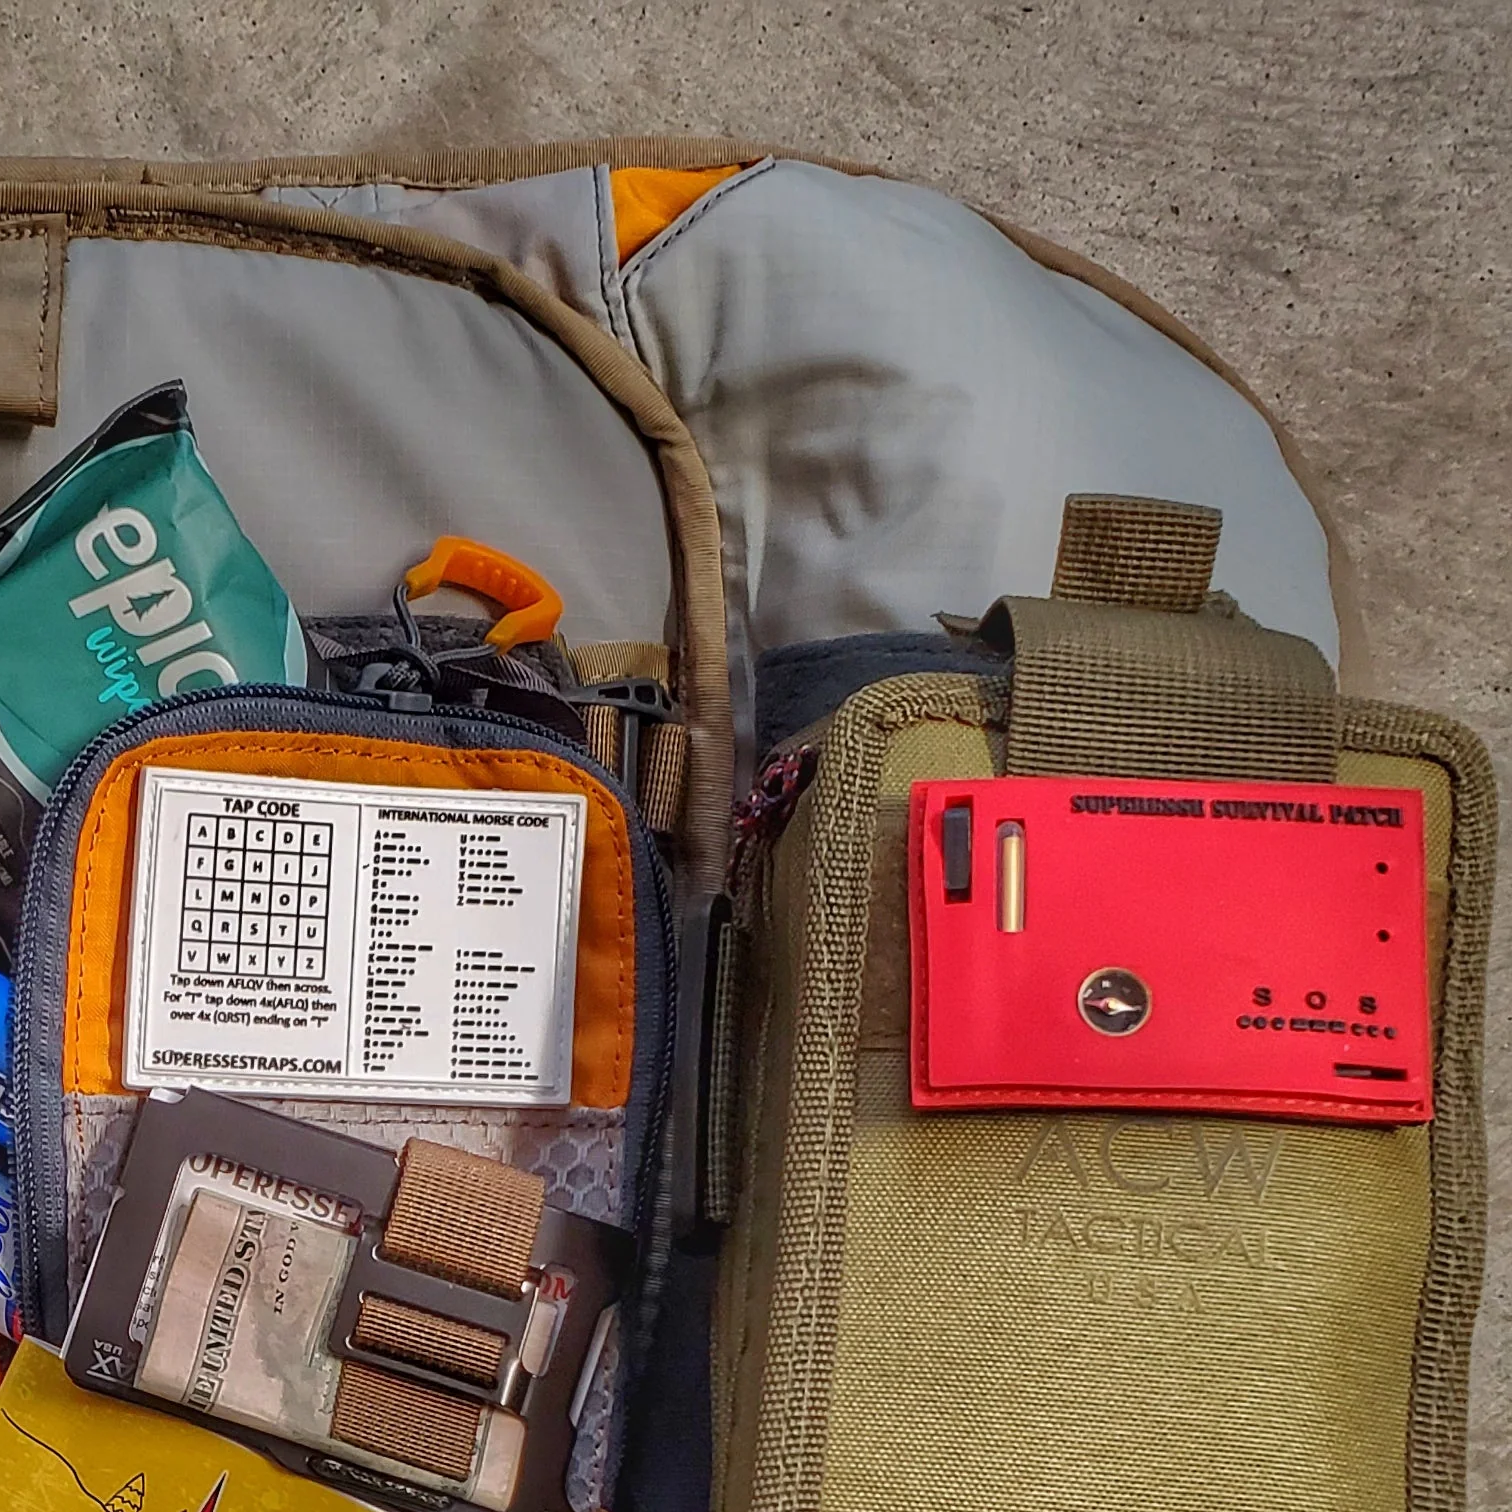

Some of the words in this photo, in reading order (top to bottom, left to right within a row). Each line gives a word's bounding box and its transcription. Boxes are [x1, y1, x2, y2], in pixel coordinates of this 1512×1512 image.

[223, 798, 254, 814] TAP
[257, 801, 300, 817] CODE
[1212, 800, 1324, 823] SURVIVAL
[1329, 804, 1403, 829] PATCH
[378, 809, 470, 824] INTERNATIONAL
[473, 813, 514, 825] MORSE
[517, 816, 549, 828] CODE
[197, 825, 207, 838] A
[227, 827, 236, 841] B
[255, 829, 265, 842] C
[283, 831, 294, 845] D
[312, 833, 321, 847] E
[197, 857, 205, 869] F
[224, 859, 235, 871] G
[252, 860, 263, 873] H
[283, 862, 289, 875] I
[311, 865, 318, 877] J
[195, 888, 203, 901] L
[220, 889, 235, 902] M
[250, 891, 262, 905] N
[279, 893, 291, 907] O
[309, 895, 318, 908] P
[191, 919, 203, 933] Q
[221, 921, 230, 933] R
[249, 923, 259, 936] S
[278, 925, 288, 937] T
[306, 926, 317, 939] U
[187, 950, 197, 962] V
[216, 952, 231, 964] W
[248, 954, 257, 966] X
[277, 955, 286, 968] Y
[305, 957, 314, 970] Z
[170, 974, 190, 987] Tap
[193, 975, 224, 988] down
[227, 977, 263, 991] AFLQV
[266, 979, 291, 992] then
[294, 983, 332, 994] across.
[164, 991, 182, 1002] For
[205, 994, 223, 1007] tap
[226, 994, 256, 1007] down
[311, 999, 336, 1011] then
[1253, 987, 1272, 1006] S
[1305, 991, 1327, 1009] O
[1359, 995, 1377, 1014] S
[170, 1011, 195, 1020] over
[197, 1010, 211, 1021] 4x
[214, 1011, 250, 1026] (QRST)
[253, 1014, 290, 1028] ending
[293, 1018, 307, 1027] on
[152, 1049, 341, 1073] SUPERESSESTRAPS.COM
[1015, 1114, 1285, 1204] ACW
[279, 1238, 297, 1283] GOD
[274, 1289, 285, 1315] IN
[202, 1266, 247, 1372] UNITED
